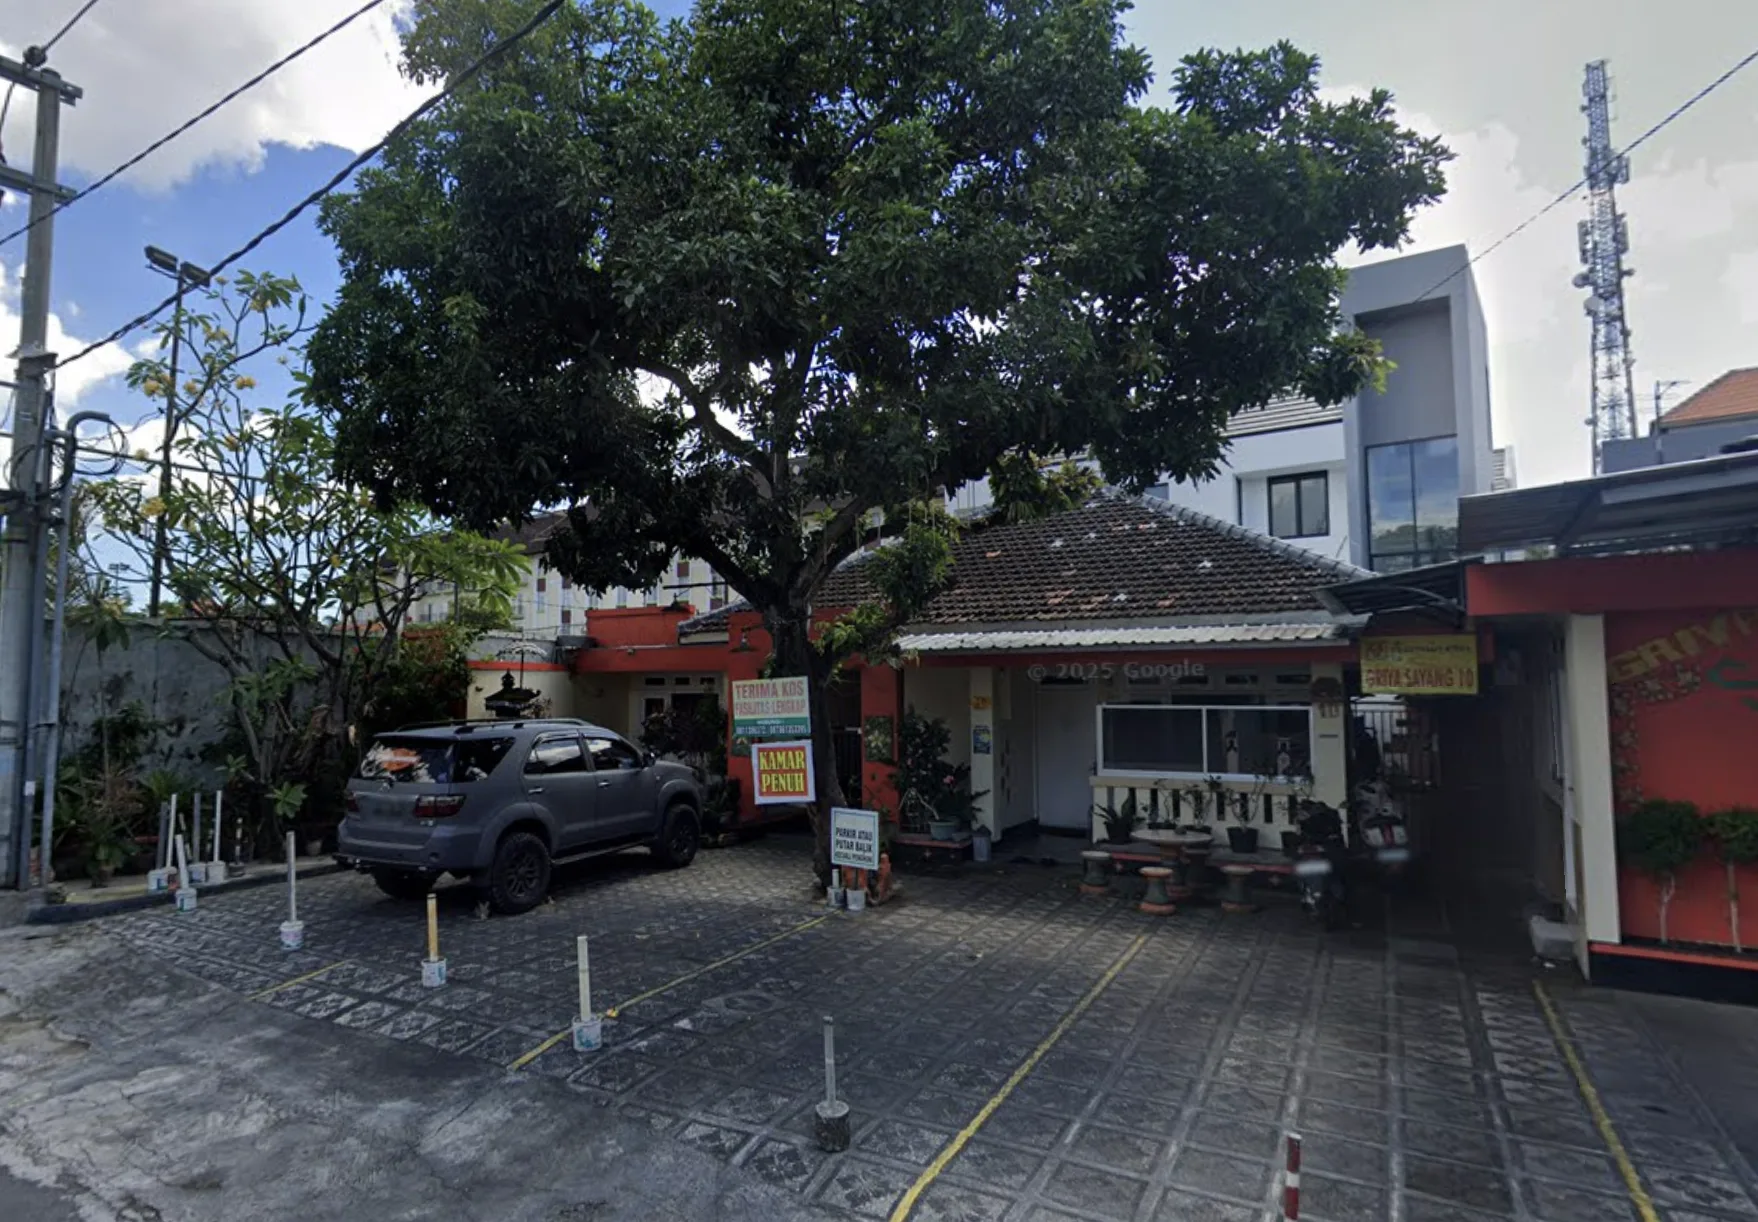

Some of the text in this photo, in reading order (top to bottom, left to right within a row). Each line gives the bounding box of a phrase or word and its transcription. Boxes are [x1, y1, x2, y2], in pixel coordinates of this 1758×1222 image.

[1404, 666, 1454, 688] SAYANG
[735, 680, 805, 700] TERIMA KOS
[759, 750, 805, 770] KAMAR
[761, 773, 805, 793] PENUH
[835, 827, 856, 839] PARKIR
[835, 839, 873, 853] PUTAR BALIK
